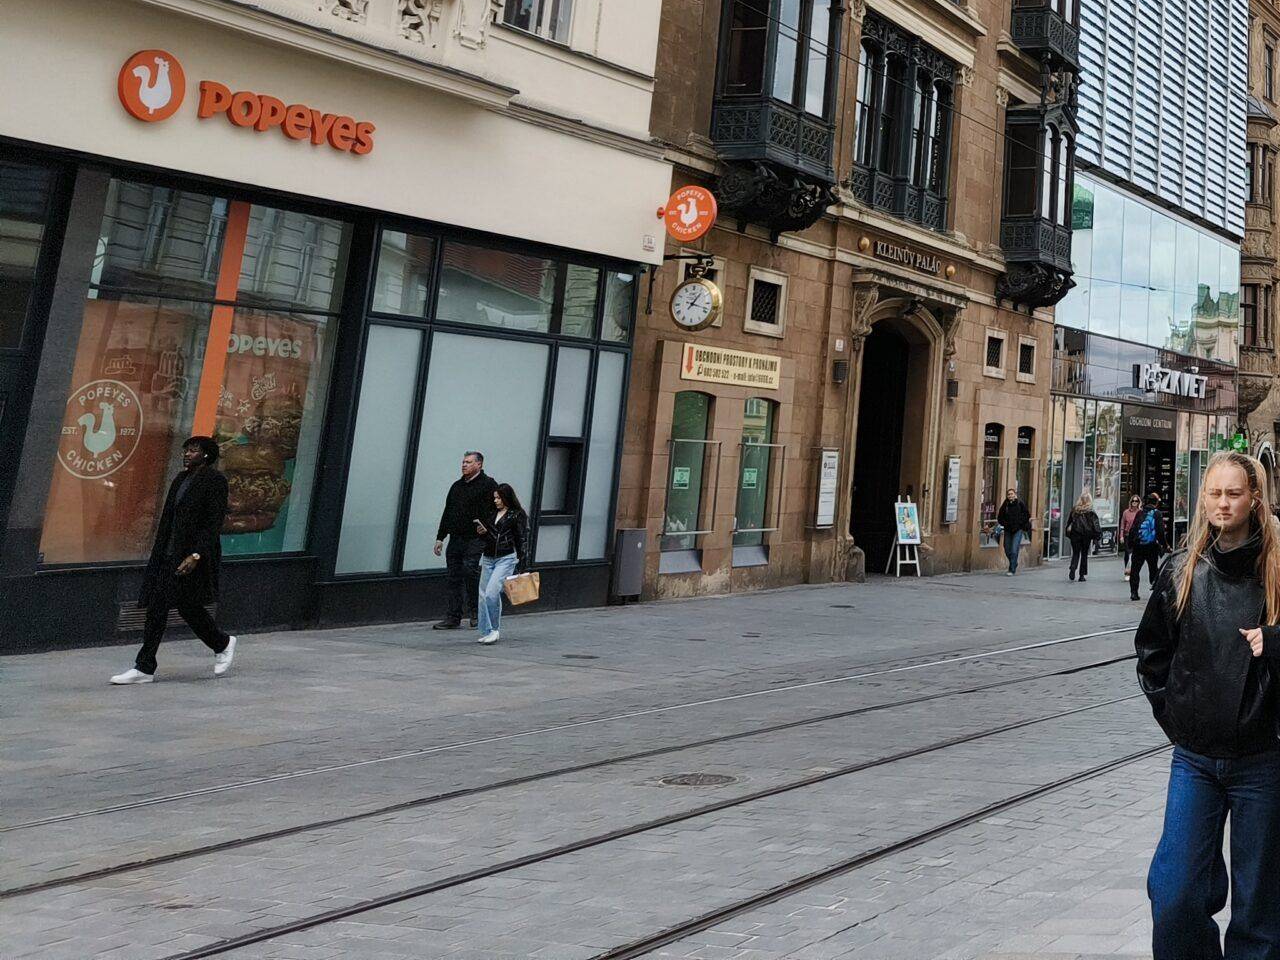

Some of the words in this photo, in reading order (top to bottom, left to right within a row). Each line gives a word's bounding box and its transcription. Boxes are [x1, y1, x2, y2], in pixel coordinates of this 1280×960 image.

[876, 240, 915, 265] KLEINŮV
[916, 253, 942, 274] PALÁC
[695, 349, 722, 364] OBCHODNÍ
[723, 353, 748, 368] PROSTORY
[79, 387, 131, 407] POPEYES
[61, 426, 78, 435] EST.
[66, 450, 123, 472] CHICKEN
